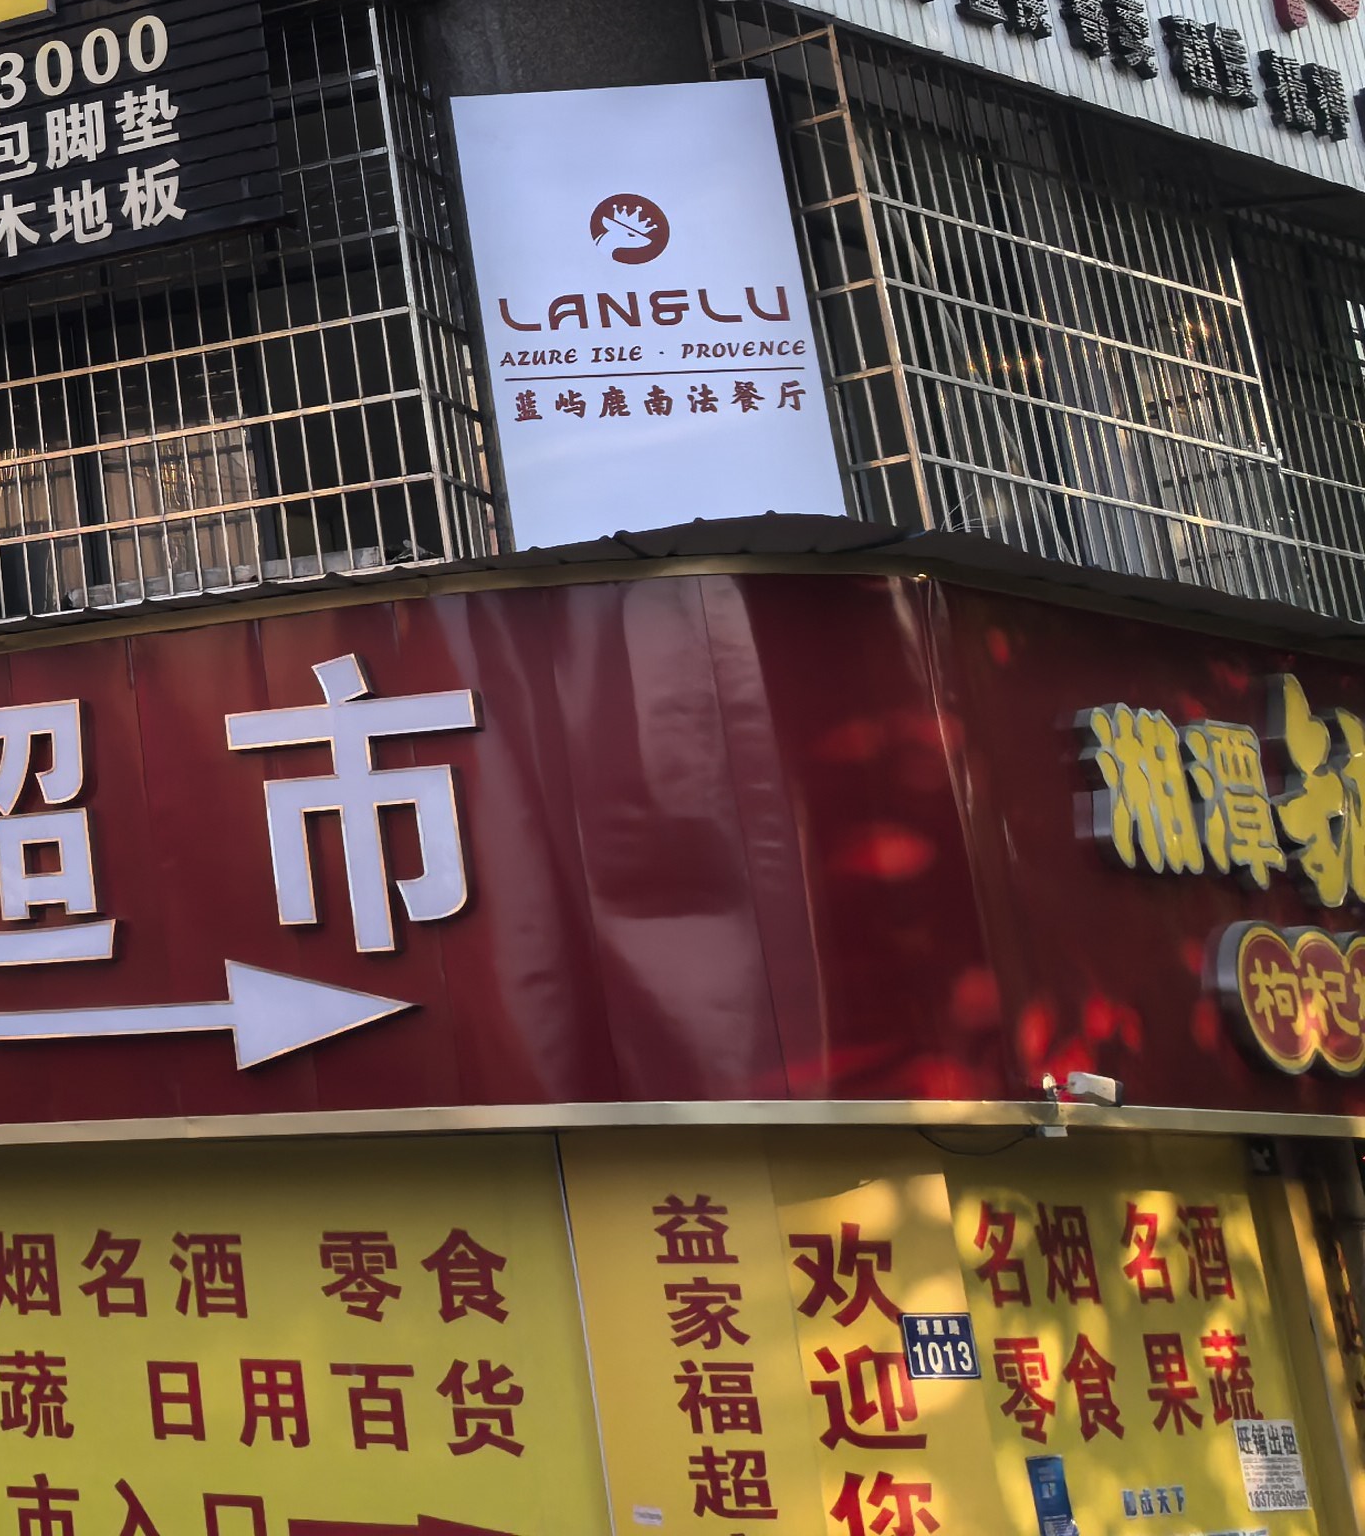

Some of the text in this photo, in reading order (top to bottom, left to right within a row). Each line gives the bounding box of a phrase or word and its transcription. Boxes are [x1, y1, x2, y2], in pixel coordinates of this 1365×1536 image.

[500, 340, 806, 367] AZURE ISLE PROVENCE
[514, 380, 807, 423] 蓝屿鹿南法餐厅
[318, 1227, 510, 1325] 零食
[973, 1200, 1236, 1310] 名烟名酒
[653, 1194, 779, 1536] 益家福超
[788, 1221, 942, 1536] 欢迎你
[912, 1341, 973, 1374] 1013
[146, 1358, 525, 1458] 日用百货
